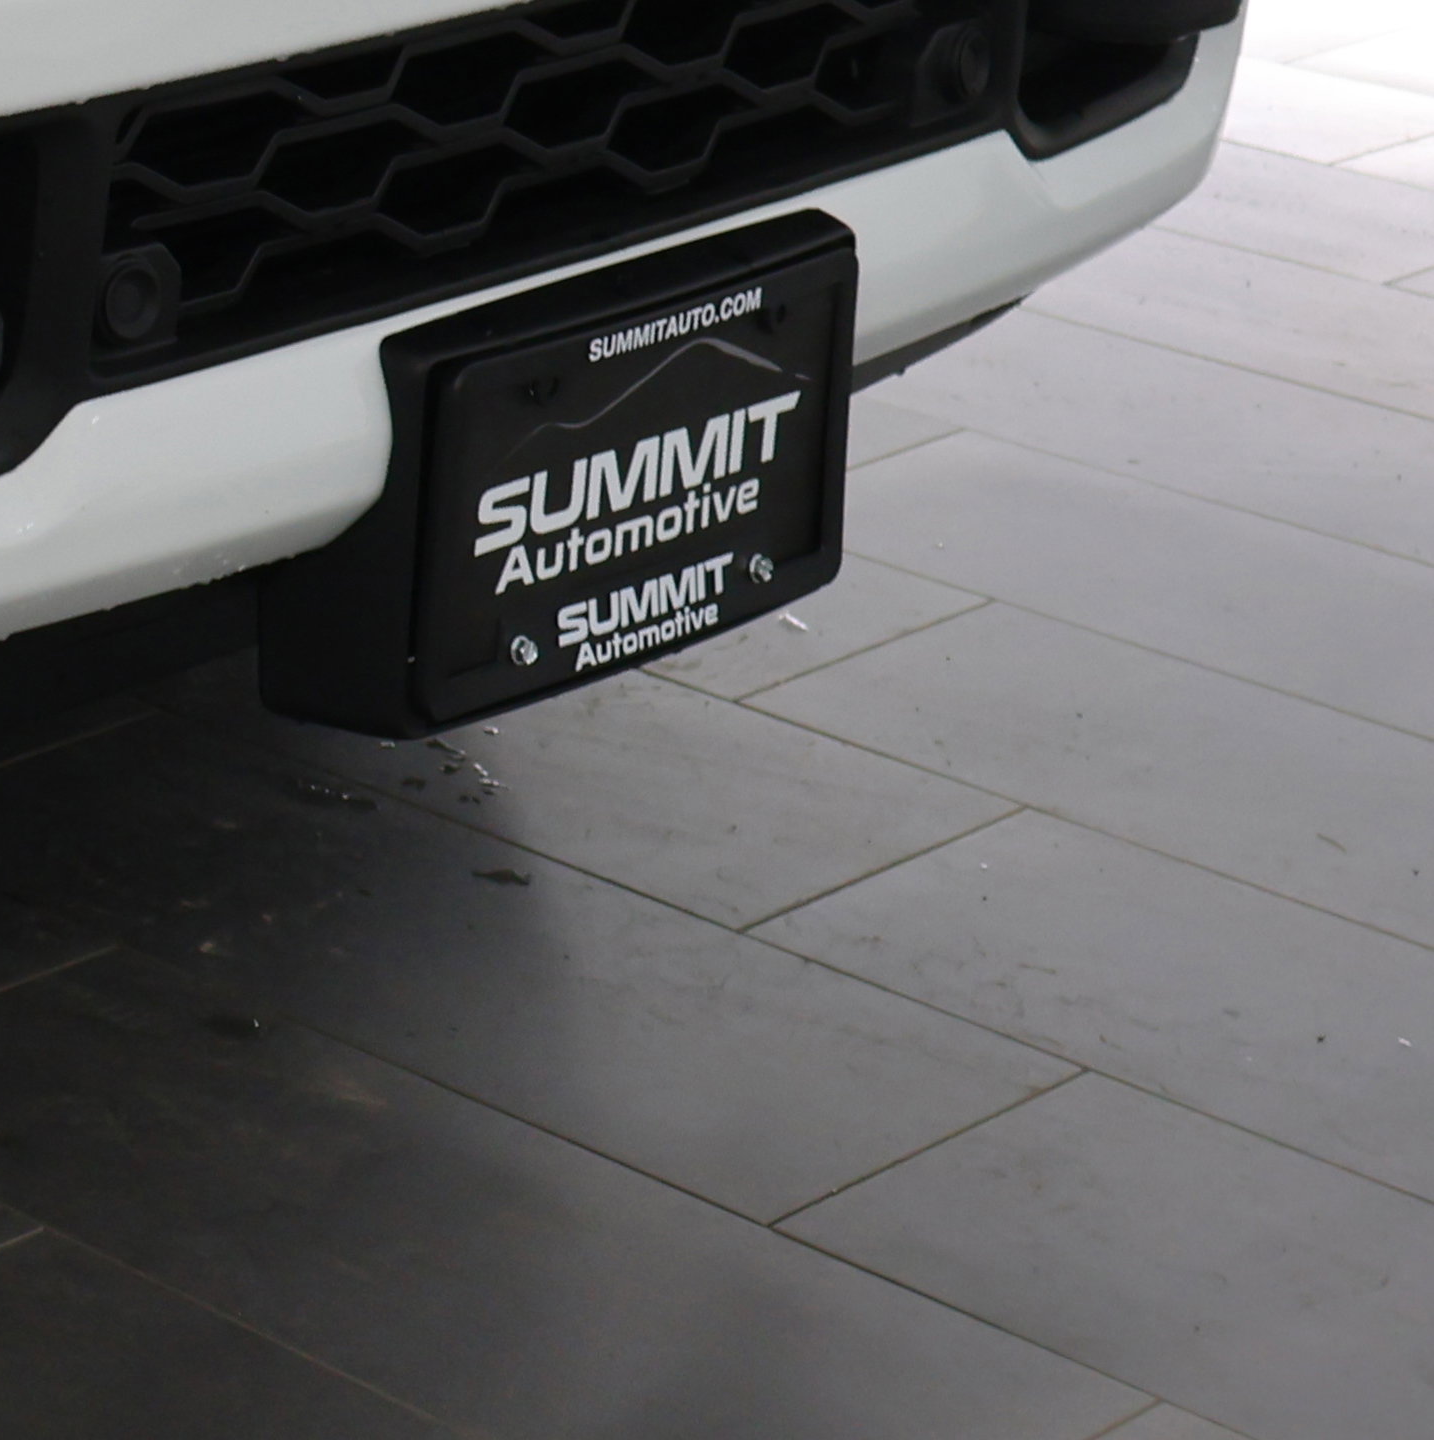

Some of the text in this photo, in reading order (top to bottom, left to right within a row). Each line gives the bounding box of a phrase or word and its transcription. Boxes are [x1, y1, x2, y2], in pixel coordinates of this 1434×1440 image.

[588, 288, 761, 362] SUMMITAUTO.COM
[475, 391, 800, 556] SUMMIT
[496, 478, 759, 594] Automotive
[558, 553, 733, 648] SUMMIT
[576, 604, 718, 671] Automotive
